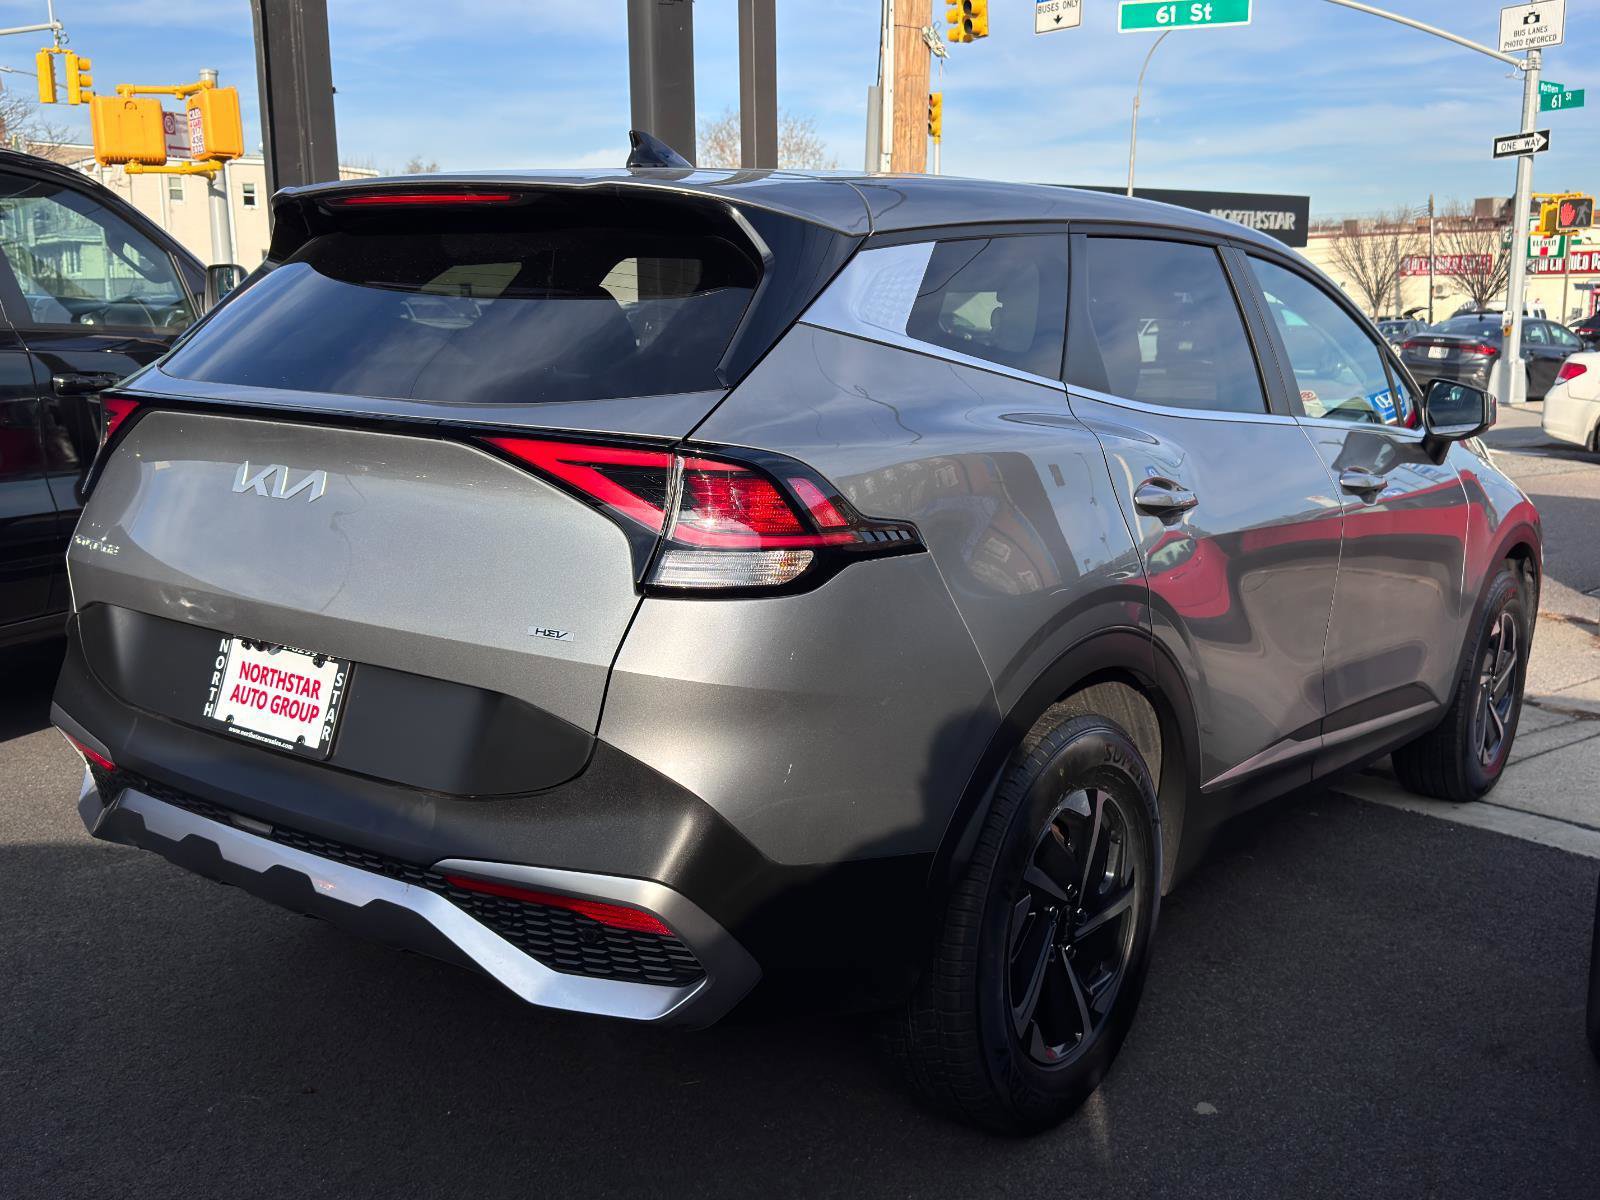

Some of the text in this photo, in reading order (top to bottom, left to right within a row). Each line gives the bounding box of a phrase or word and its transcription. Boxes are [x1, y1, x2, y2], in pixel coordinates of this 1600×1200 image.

[1037, 0, 1079, 14] BUSES ONLY
[1155, 3, 1213, 24] 61 St
[1513, 25, 1549, 38] BUS LANES
[1504, 34, 1558, 49] PHOTO ENFORCED
[1551, 91, 1572, 108] 61 St
[1501, 137, 1542, 152] ONE WAY
[232, 460, 327, 503] KIA
[535, 627, 569, 639] HEV
[203, 638, 230, 718] NORTH
[239, 661, 322, 700] NORTHSTAR
[229, 683, 320, 724] AUTO GROUP
[320, 672, 345, 742] STAR
